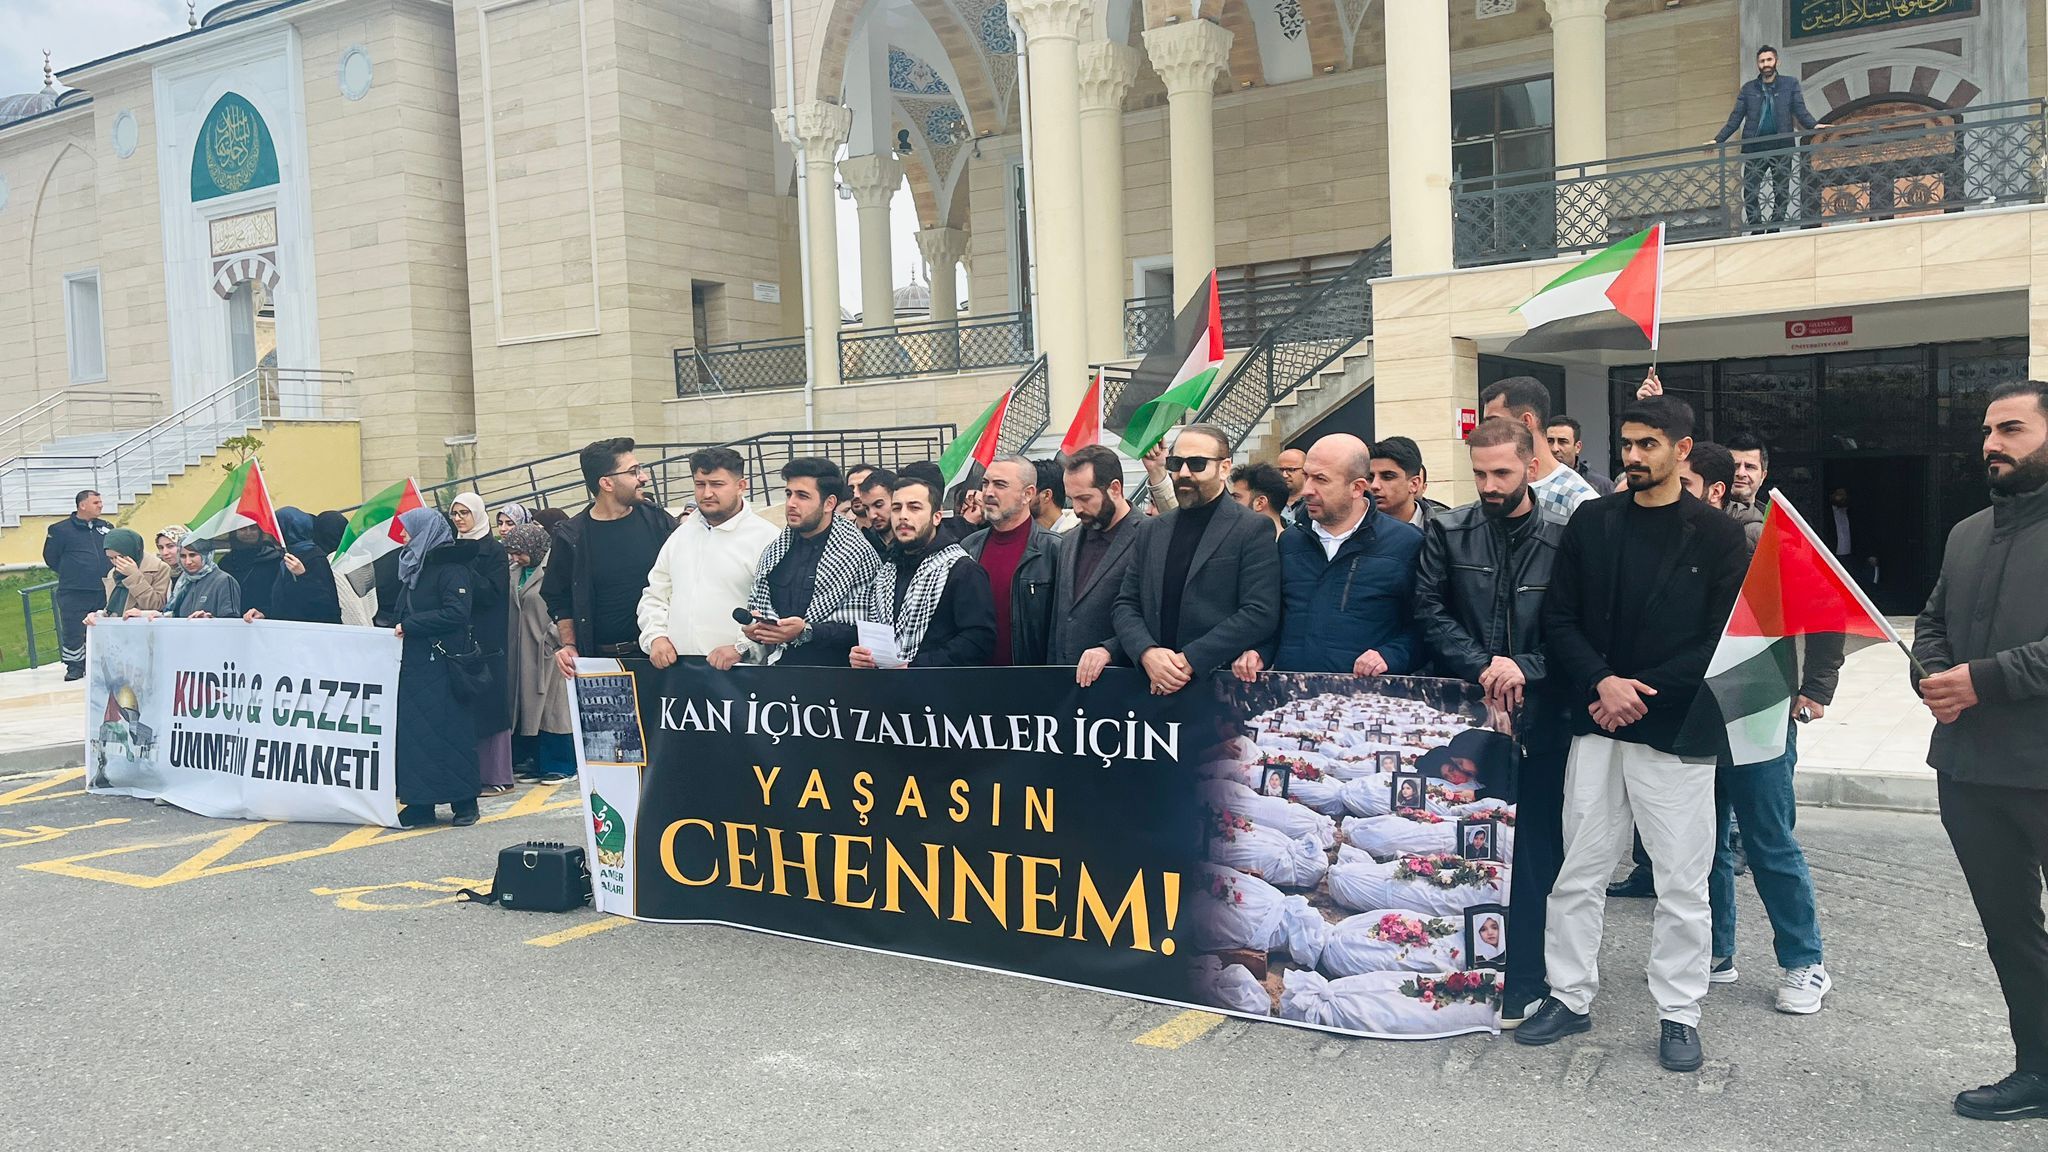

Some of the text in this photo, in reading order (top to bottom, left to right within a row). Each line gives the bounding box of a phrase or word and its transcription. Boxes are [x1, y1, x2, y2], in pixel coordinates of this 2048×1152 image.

[272, 676, 382, 735] GAZZE
[659, 692, 1182, 769] KAN İÇİCİ ZALİMLER İÇİN
[170, 722, 380, 791] ÜMMETİN EMANETİ
[752, 765, 1054, 833] YAŞASIN
[659, 818, 1181, 956] CEHENNEM!
